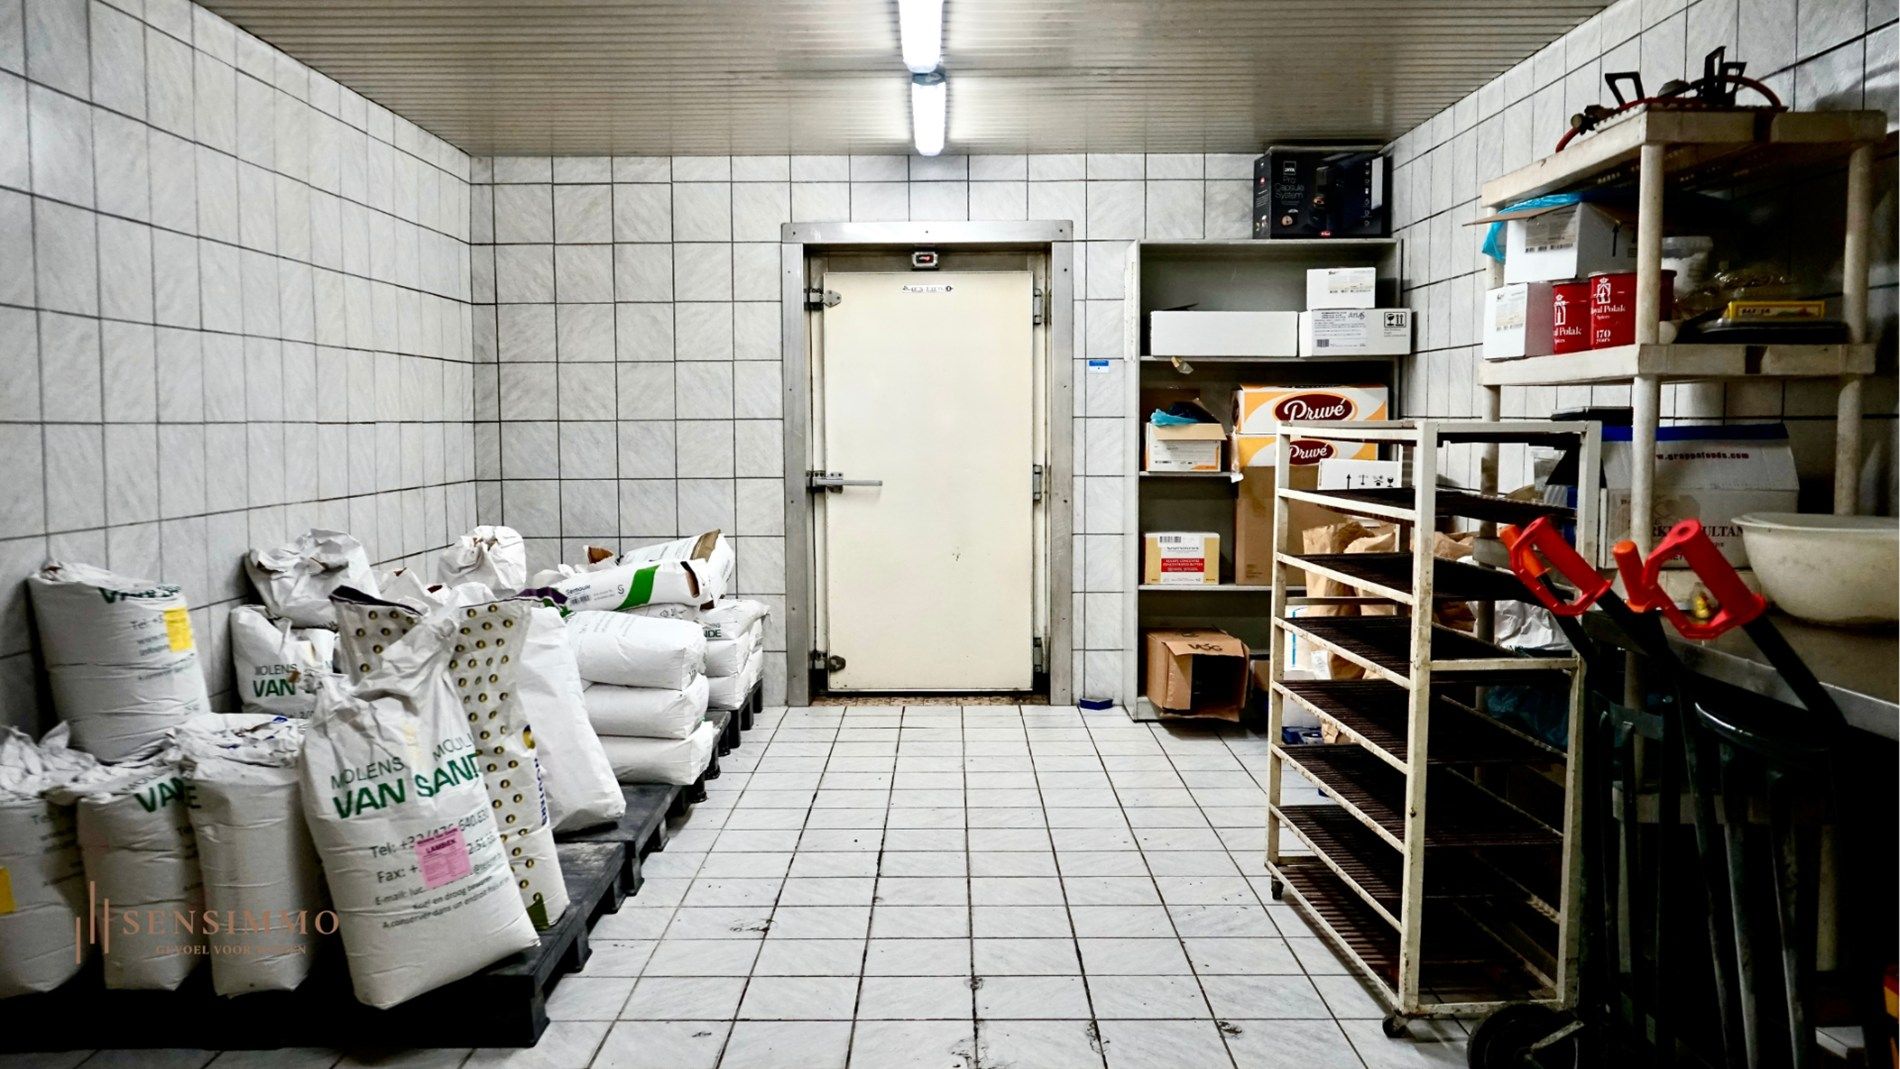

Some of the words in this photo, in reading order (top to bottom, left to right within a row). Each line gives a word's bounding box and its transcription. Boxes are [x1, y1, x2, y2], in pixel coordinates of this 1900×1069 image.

[1283, 176, 1296, 184] Pro
[1274, 183, 1305, 193] Capsule
[1274, 191, 1304, 200] System
[1603, 304, 1626, 313] Polak
[1559, 327, 1582, 336] Polak
[1596, 329, 1611, 338] 170
[1283, 397, 1346, 420] Pruvé
[1289, 443, 1328, 459] Pruvé
[252, 678, 297, 698] VAN
[330, 756, 405, 790] MOLENS
[332, 778, 407, 820] VAN
[369, 842, 396, 858] Tel:
[376, 867, 406, 884] Fax:
[444, 888, 467, 901] droog
